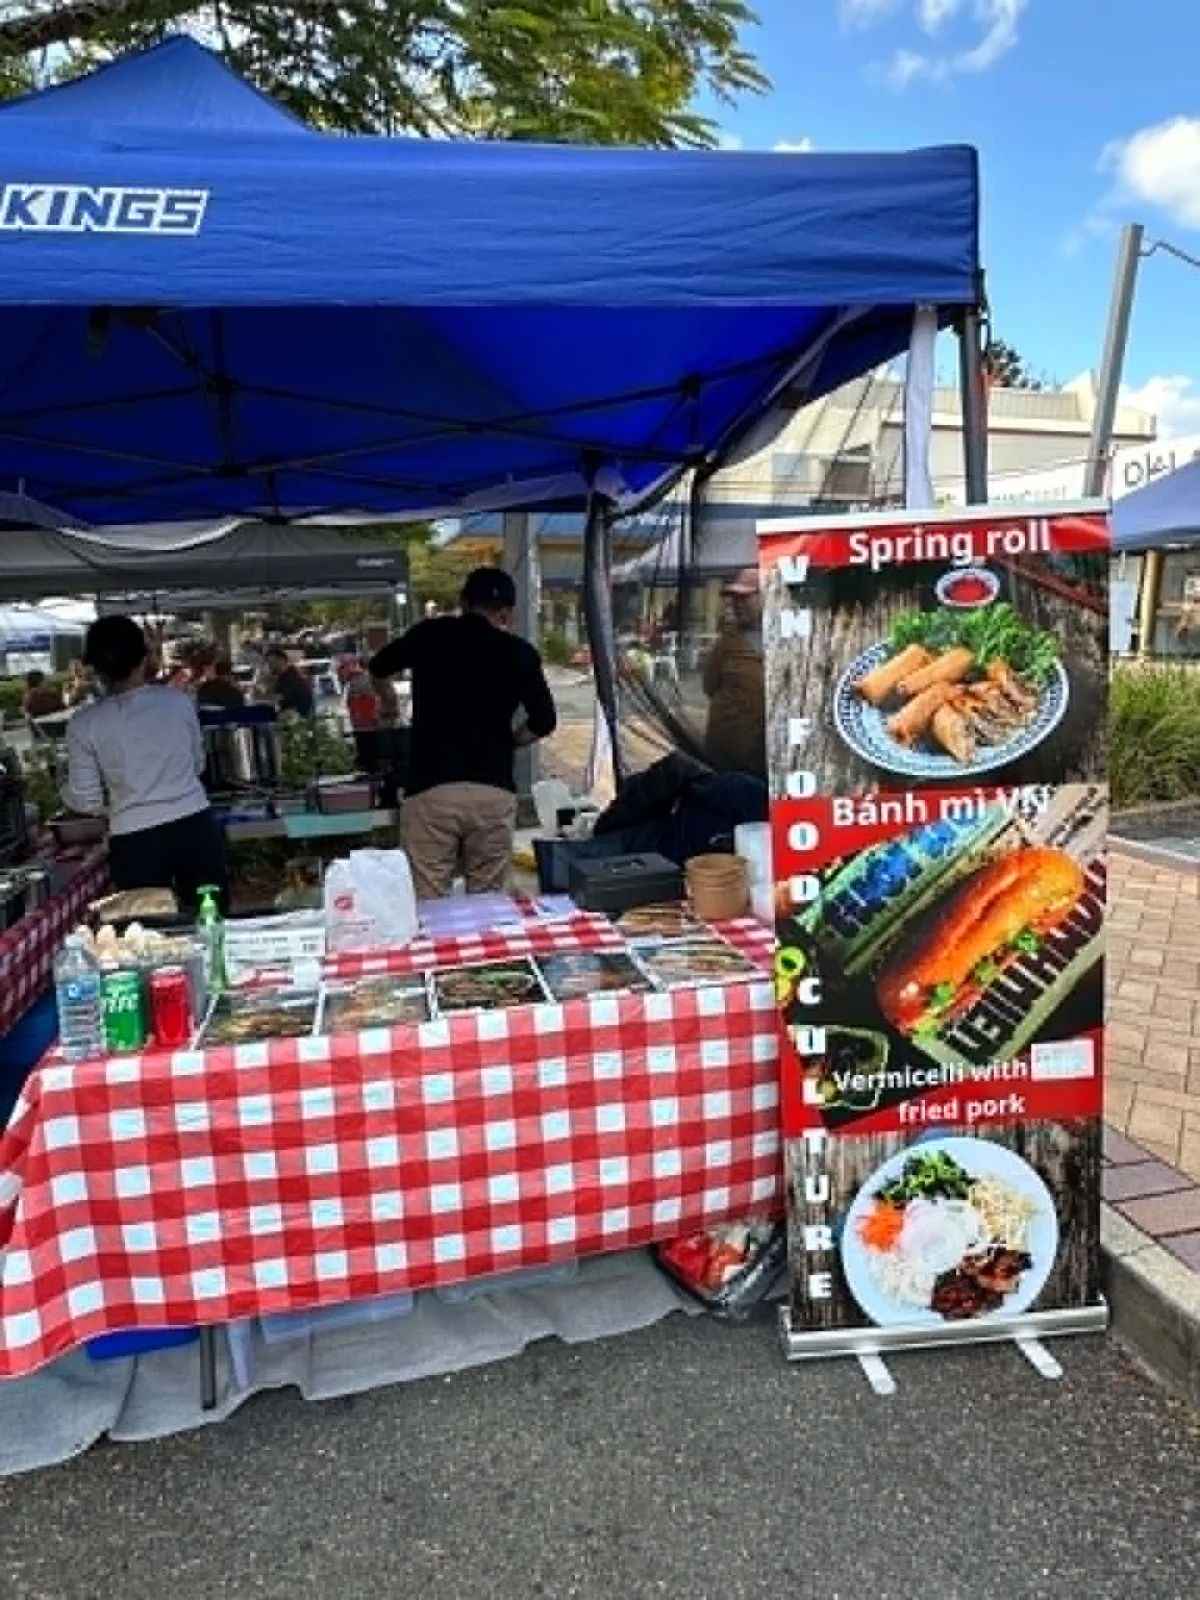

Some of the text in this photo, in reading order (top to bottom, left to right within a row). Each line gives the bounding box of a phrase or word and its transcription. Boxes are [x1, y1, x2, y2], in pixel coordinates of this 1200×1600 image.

[1, 184, 209, 236] KINGS
[850, 519, 1050, 571] Spring roll
[832, 793, 928, 826] Bánh
[834, 1060, 965, 1092] Vermicelli
[970, 1058, 1030, 1083] with
[898, 1093, 1026, 1124] fried pork
[797, 977, 833, 1300] CULTURE
